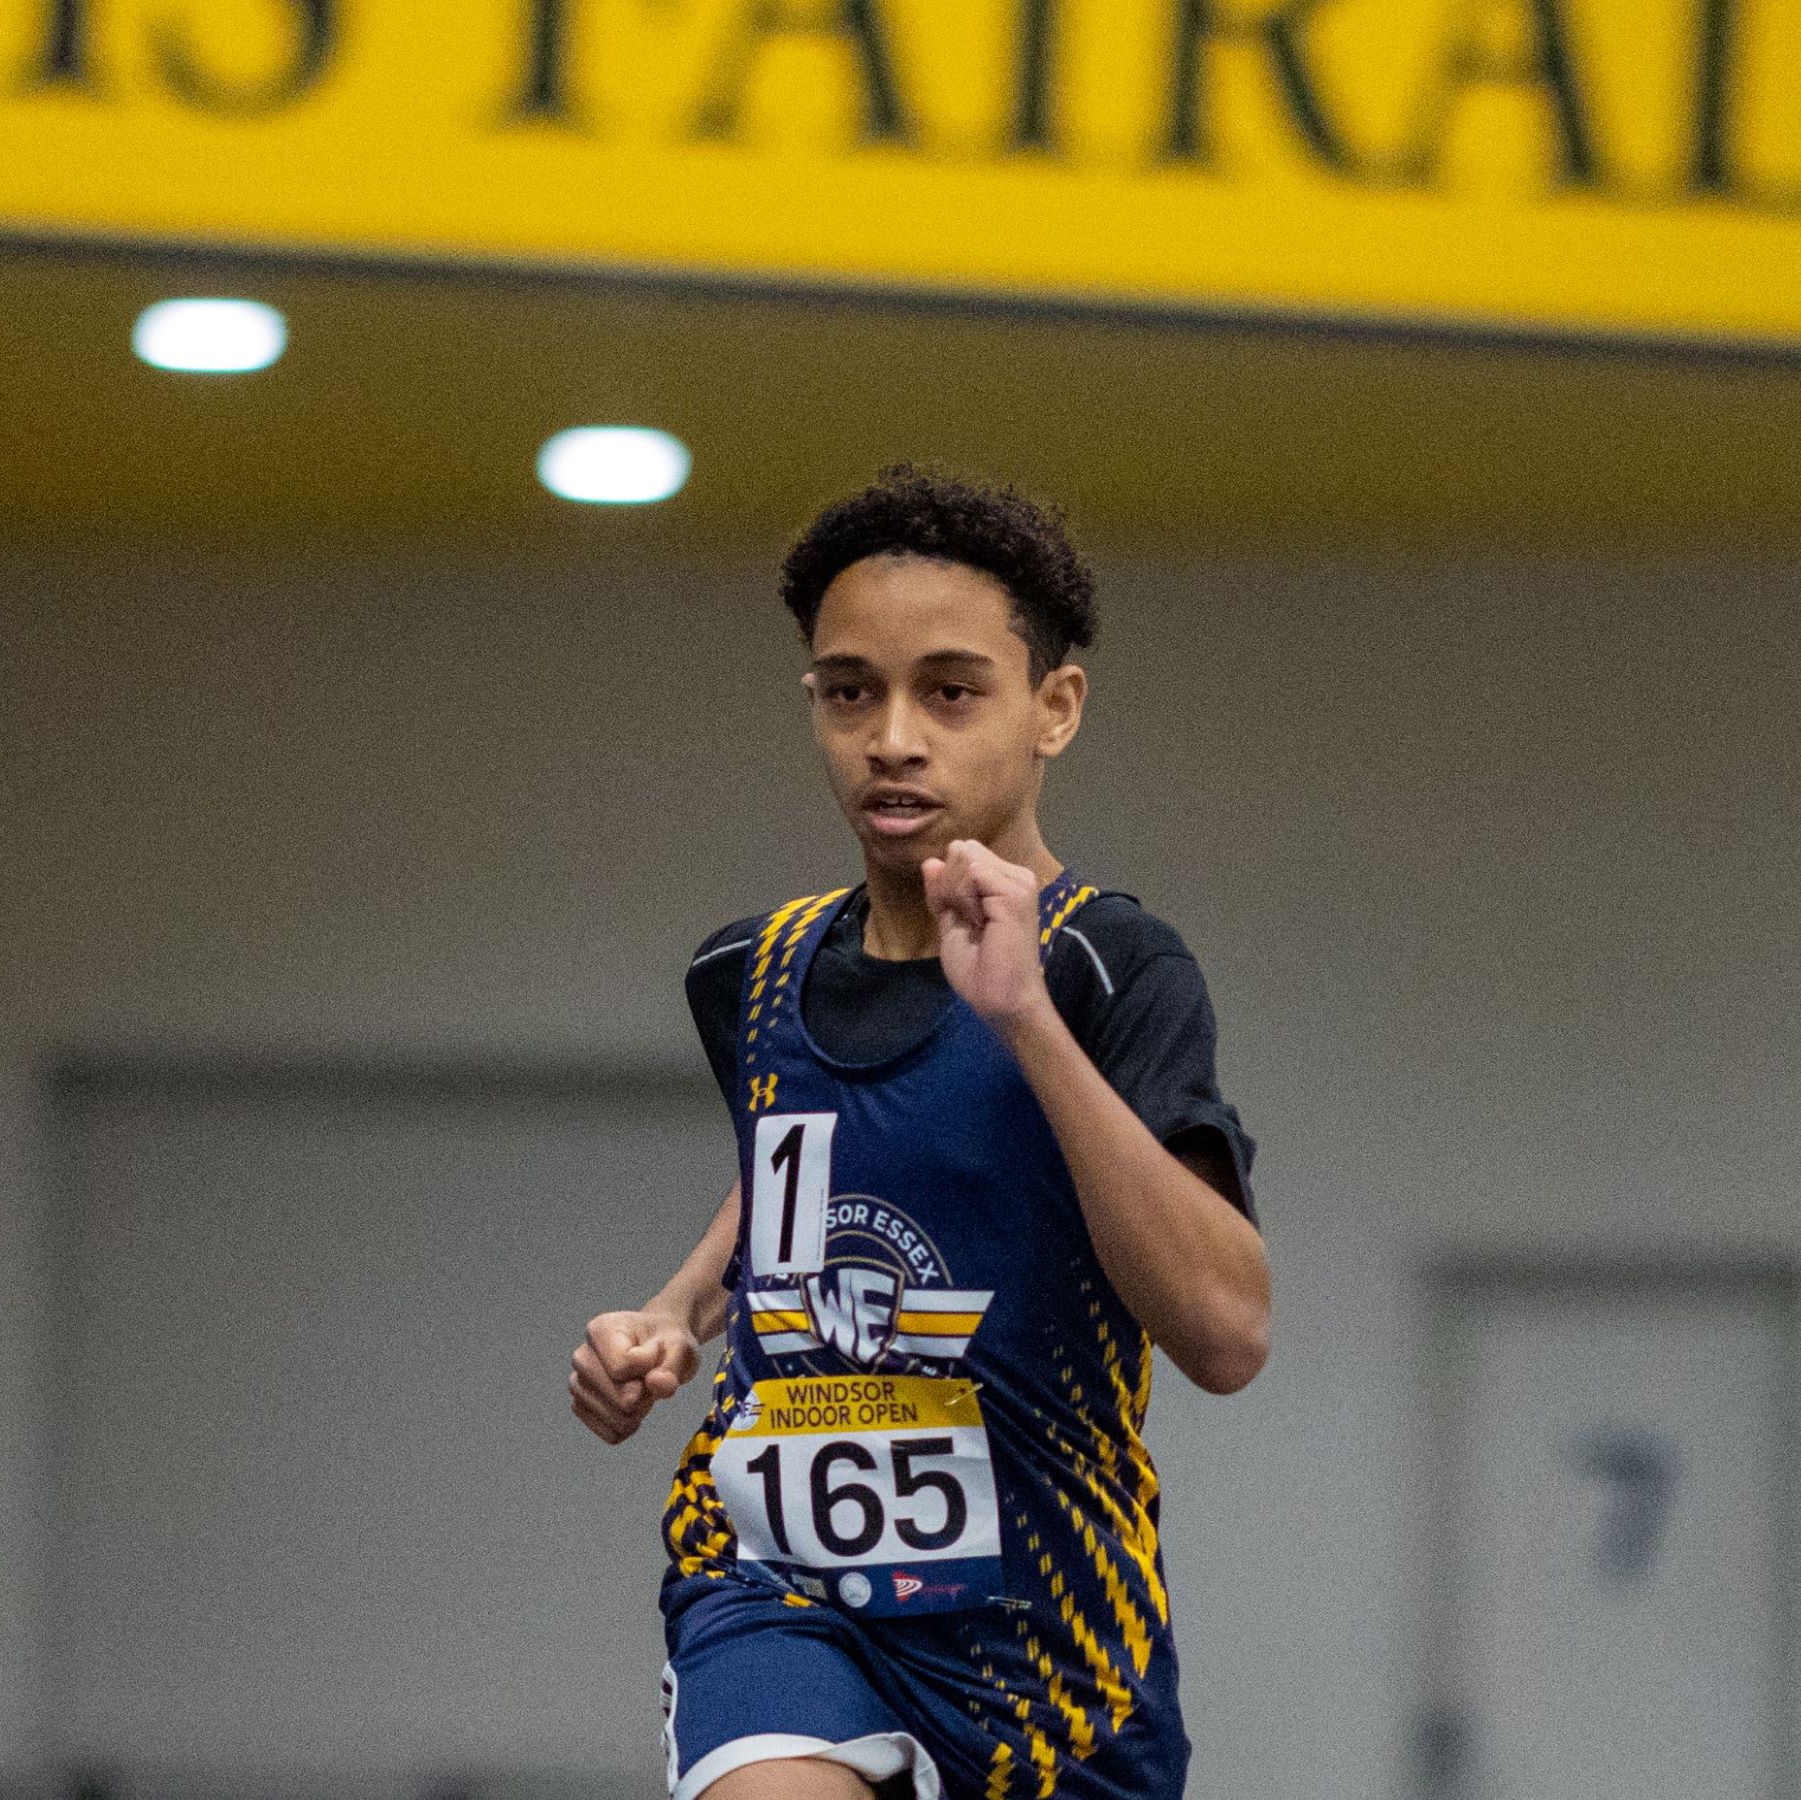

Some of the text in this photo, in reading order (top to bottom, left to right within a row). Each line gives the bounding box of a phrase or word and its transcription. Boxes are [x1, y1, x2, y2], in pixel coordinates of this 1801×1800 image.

[771, 1123, 806, 1264] 1
[872, 1209, 940, 1286] ESSEX
[806, 1267, 896, 1364] WE
[770, 1404, 852, 1430] INDOOR
[858, 1402, 919, 1425] OPEN
[786, 1381, 896, 1405] WINDSOR
[747, 1436, 968, 1557] 165
[1560, 1425, 1678, 1598] 7
